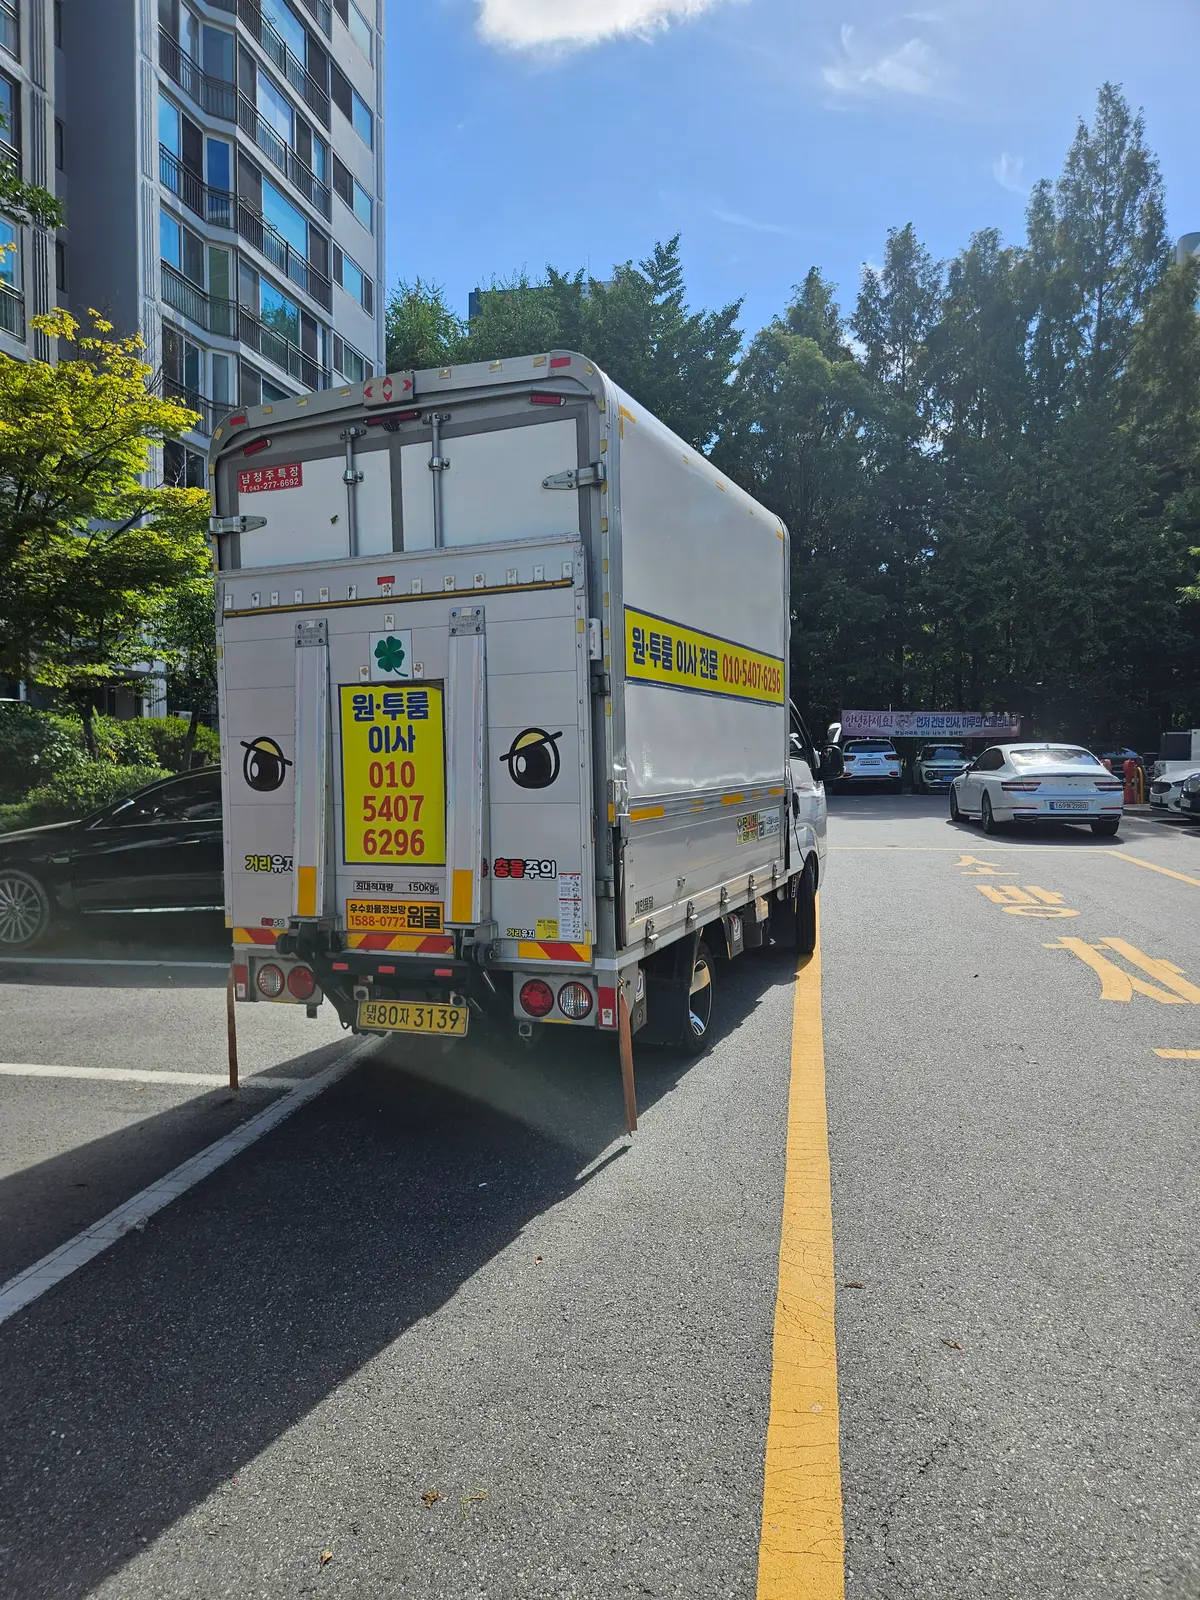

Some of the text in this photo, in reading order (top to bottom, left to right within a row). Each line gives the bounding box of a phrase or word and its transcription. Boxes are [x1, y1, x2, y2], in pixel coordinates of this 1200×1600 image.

[241, 466, 298, 484] 남청주특장
[676, 640, 697, 676] 이사
[700, 647, 718, 681] 전문
[352, 691, 429, 722] 원·투룸
[845, 714, 893, 729] 안녕하세요!
[916, 716, 930, 728] 먼저
[368, 724, 416, 754] 이사
[369, 761, 416, 788] 010
[363, 795, 425, 822] 5407
[363, 828, 425, 857] 6296
[494, 857, 556, 879] 충돌주의
[356, 882, 393, 892] 최대적재량
[350, 903, 440, 929] 우수화물정보망 원콜
[350, 915, 406, 928] 1588-0772
[413, 1008, 459, 1030] 3139
